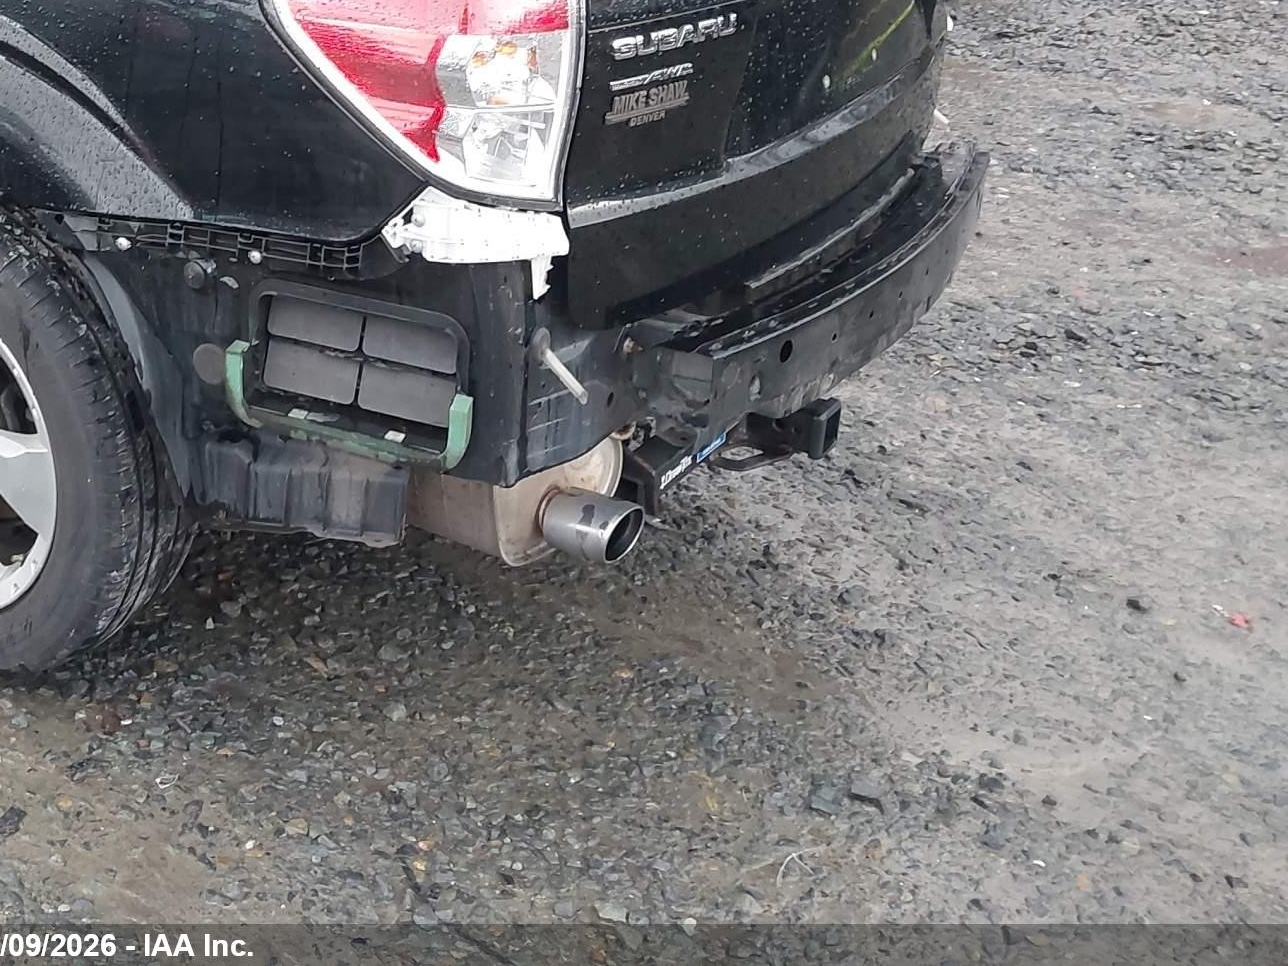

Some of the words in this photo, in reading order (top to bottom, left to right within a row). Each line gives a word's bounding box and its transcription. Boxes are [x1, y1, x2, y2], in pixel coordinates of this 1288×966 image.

[612, 13, 737, 60] SUBARU
[613, 90, 648, 114] MIKE
[649, 80, 688, 106] SHAW
[629, 110, 666, 127] DENVER
